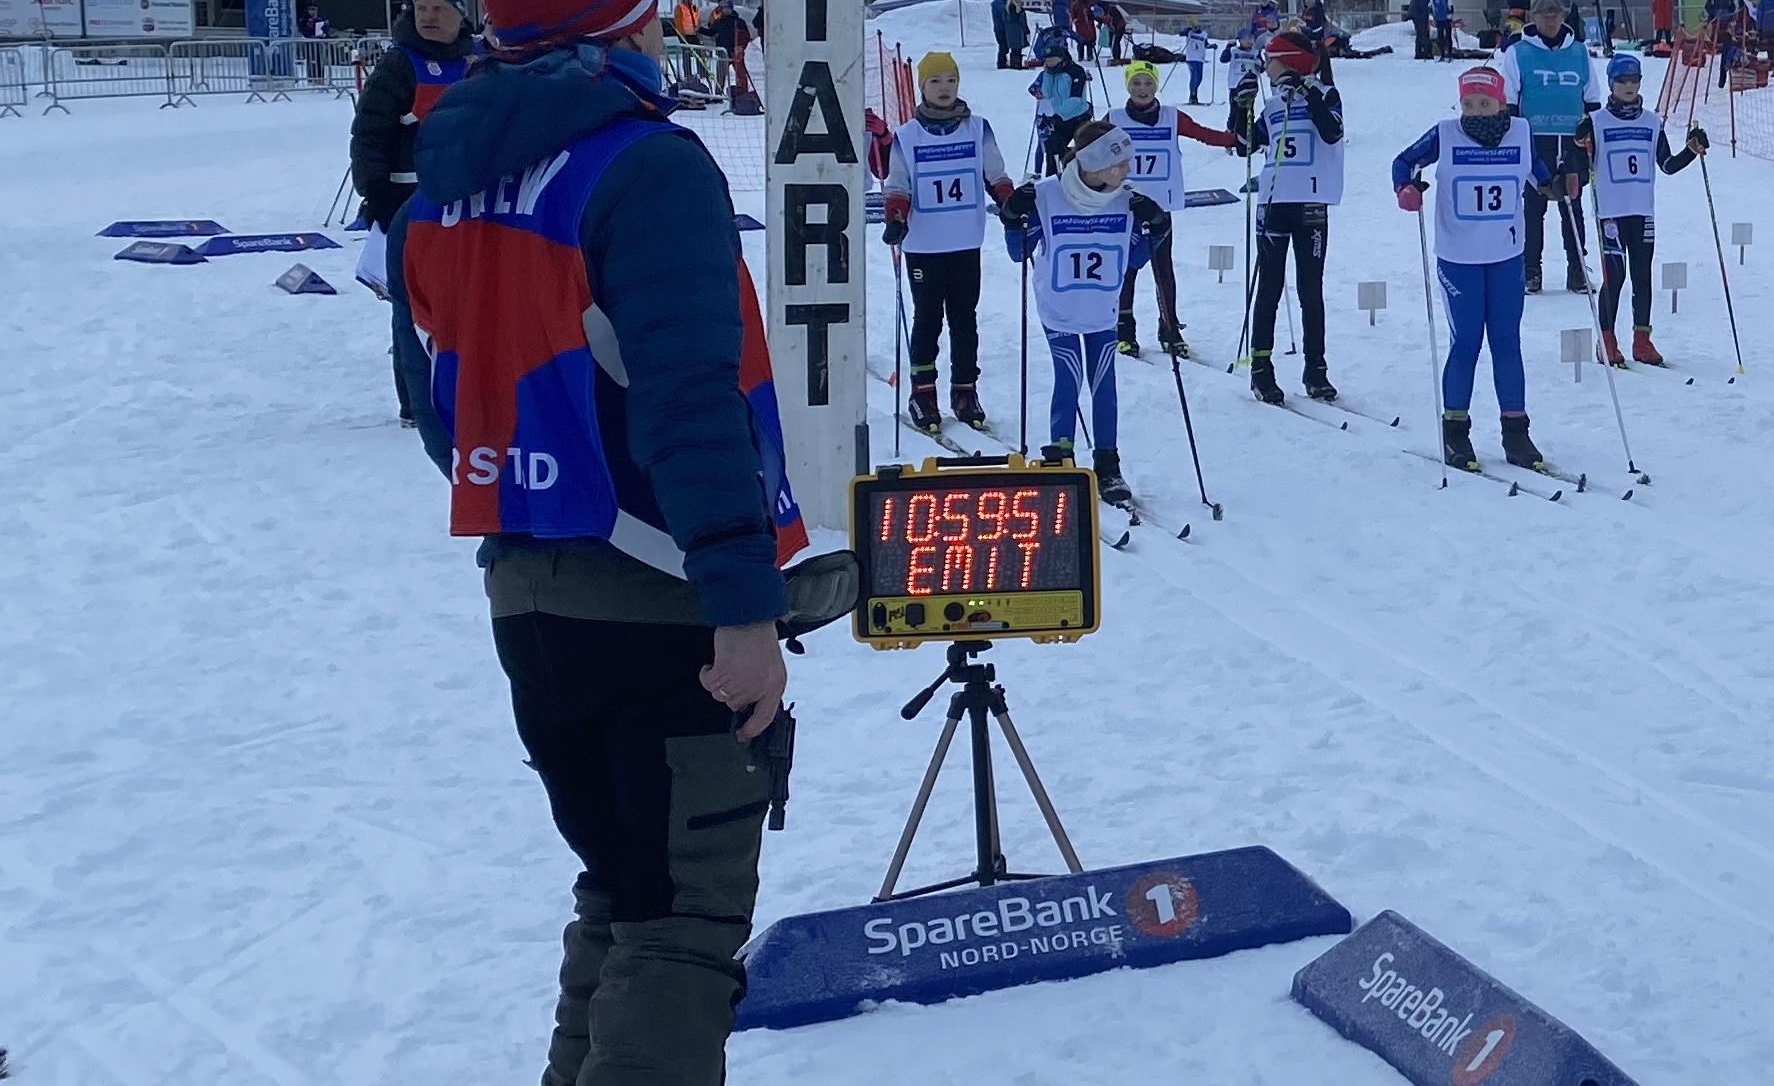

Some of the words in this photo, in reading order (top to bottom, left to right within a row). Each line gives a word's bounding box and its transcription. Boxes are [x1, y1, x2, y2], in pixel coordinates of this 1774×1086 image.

[1533, 69, 1581, 86] TD
[1134, 155, 1157, 175] 17
[1627, 154, 1638, 175] 6
[931, 177, 964, 205] 14
[1310, 176, 1317, 194] 1
[1473, 184, 1503, 212] 13
[1068, 251, 1103, 281] 12
[905, 542, 1041, 595] EMIT
[863, 885, 1119, 957] SpareBank
[1145, 883, 1176, 925] 1
[939, 924, 1124, 970] NORD-NORGE
[1358, 951, 1474, 1057] SpareBank
[1464, 1028, 1505, 1072] 1
